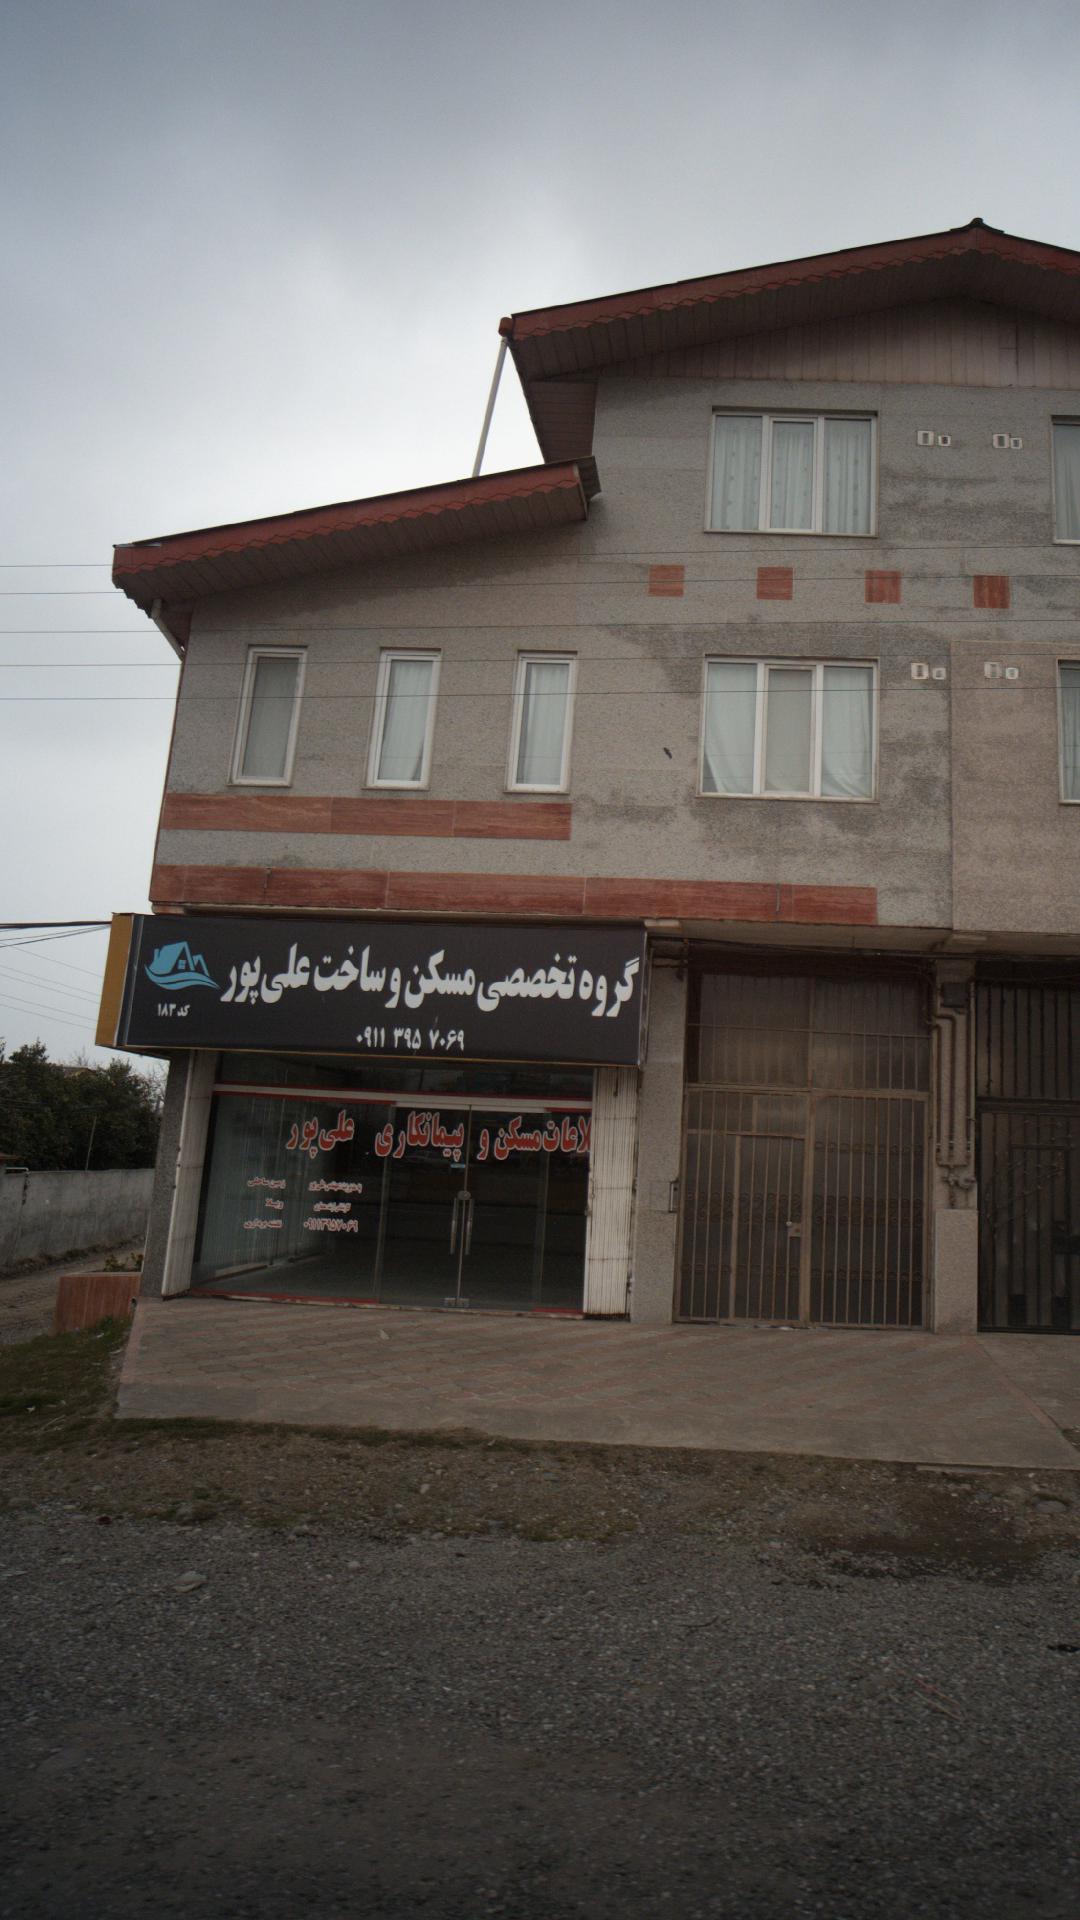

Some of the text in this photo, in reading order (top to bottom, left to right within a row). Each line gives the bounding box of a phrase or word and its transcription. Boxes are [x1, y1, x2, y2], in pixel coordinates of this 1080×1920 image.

[313, 945, 386, 992] ساخت
[384, 967, 402, 1009] و
[404, 949, 476, 1009] مسکن
[477, 953, 578, 1012] تخصصی
[579, 957, 640, 1017] گروه
[177, 1004, 191, 1017] کد
[375, 1111, 464, 1162] پیمانکاری
[476, 1128, 490, 1161] و
[493, 1115, 542, 1161] مسکن
